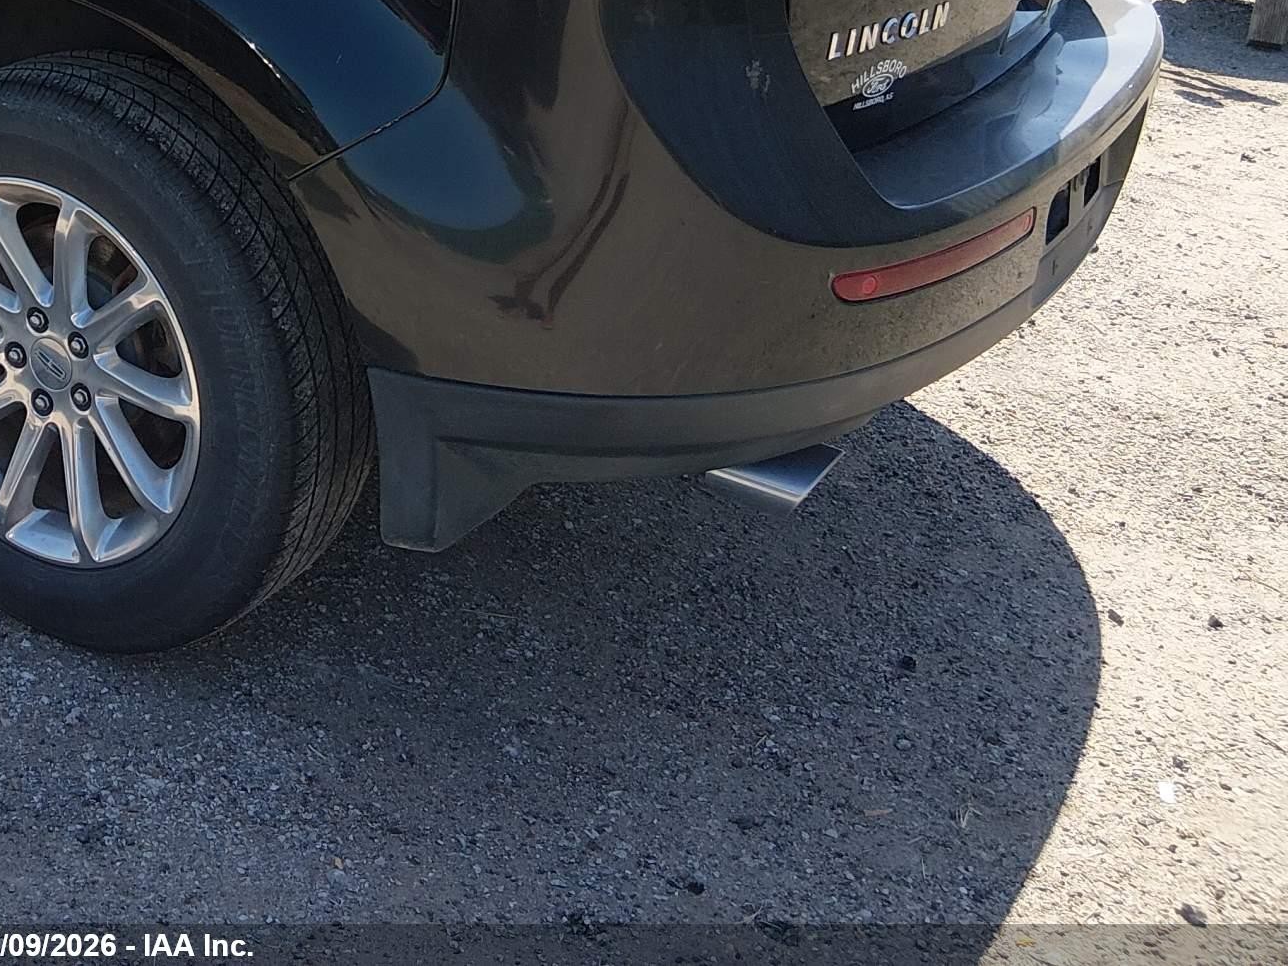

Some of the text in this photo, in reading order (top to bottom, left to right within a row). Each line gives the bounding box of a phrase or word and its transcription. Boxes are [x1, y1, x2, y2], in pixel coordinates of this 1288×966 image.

[827, 1, 950, 61] LINCOLN
[852, 59, 907, 94] HILLSBORO
[866, 77, 890, 94] Ford
